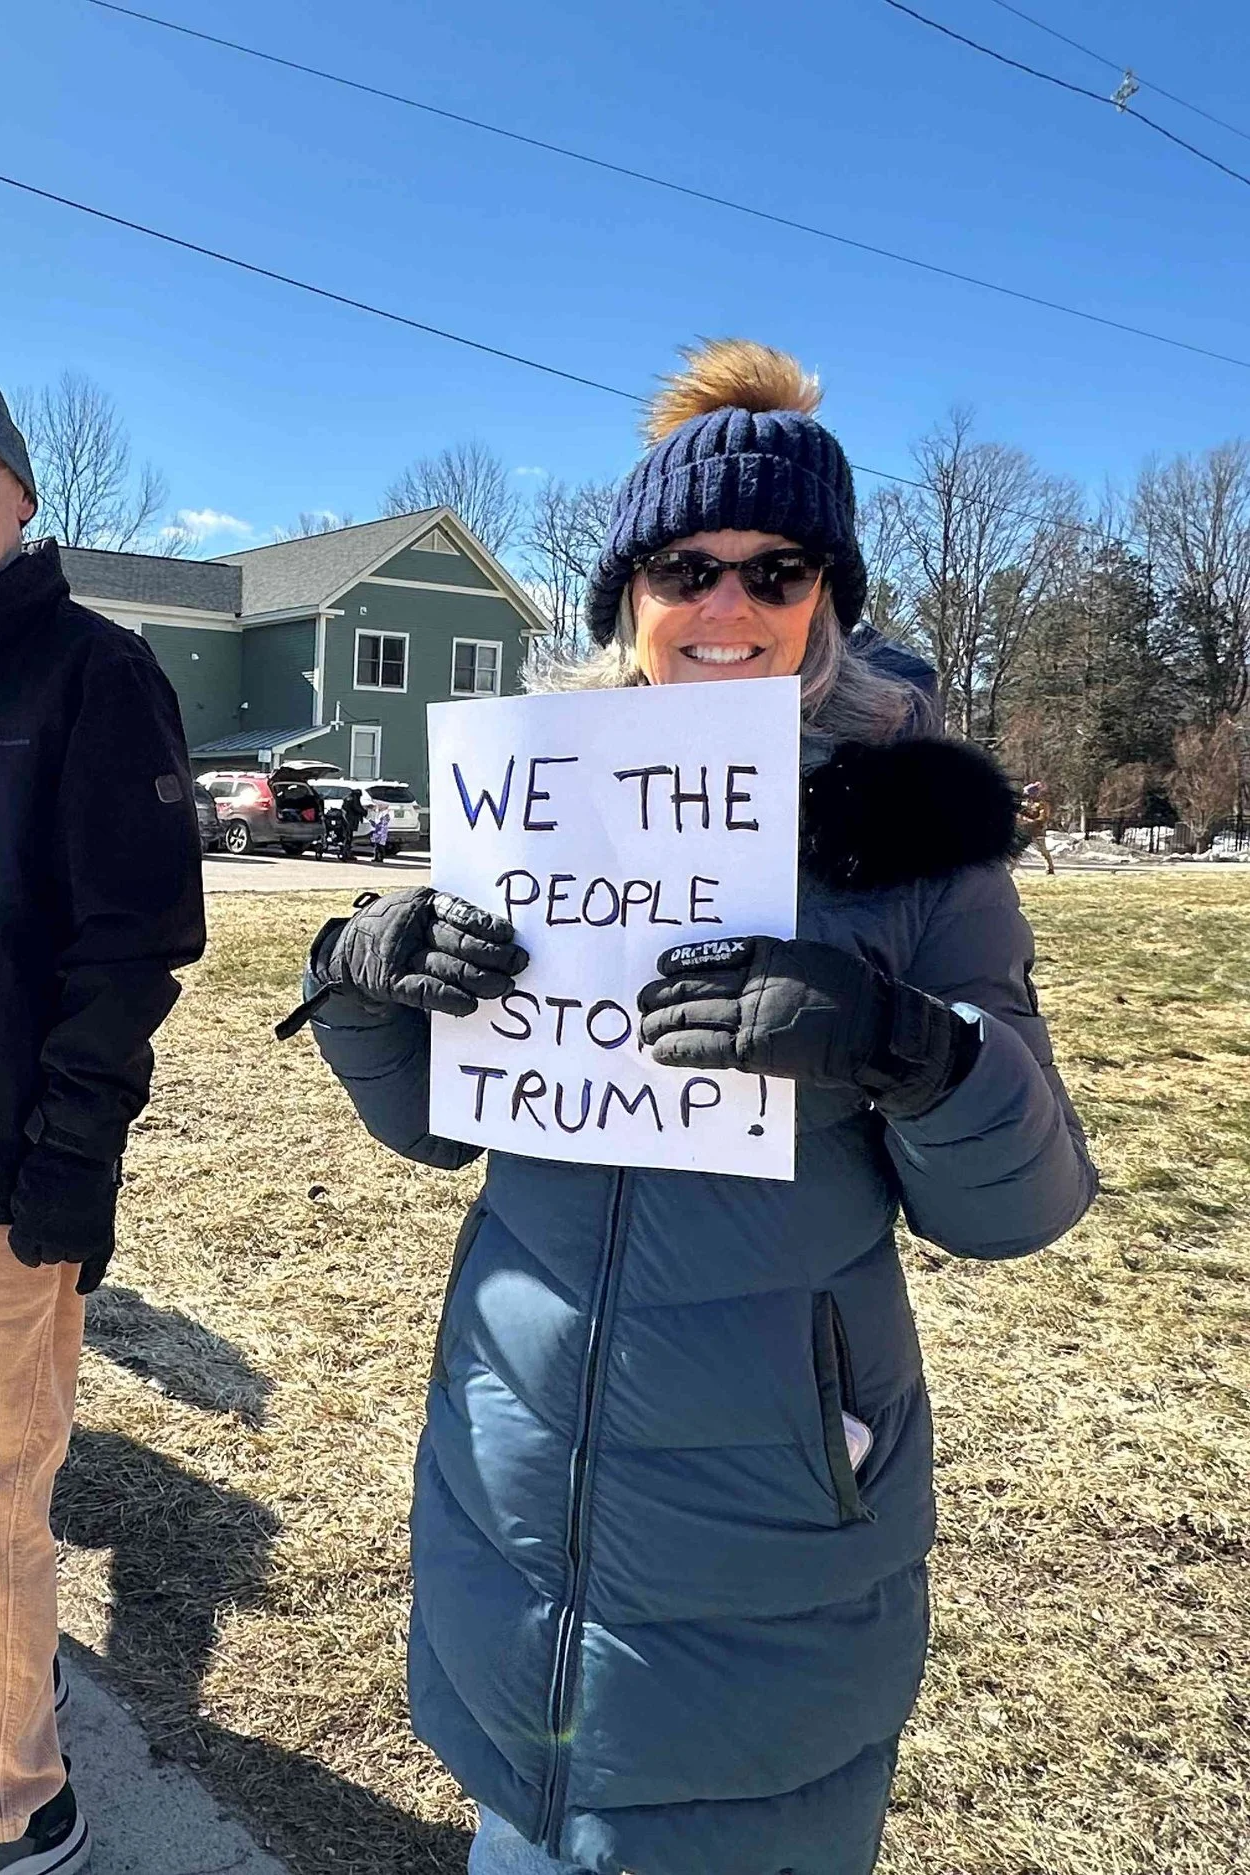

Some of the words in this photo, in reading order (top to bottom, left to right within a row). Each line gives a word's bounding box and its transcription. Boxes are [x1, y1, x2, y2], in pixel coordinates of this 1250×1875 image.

[452, 755, 578, 831] WE
[614, 765, 759, 833] THE
[495, 869, 724, 928] PEOPLE
[490, 989, 642, 1053] STO
